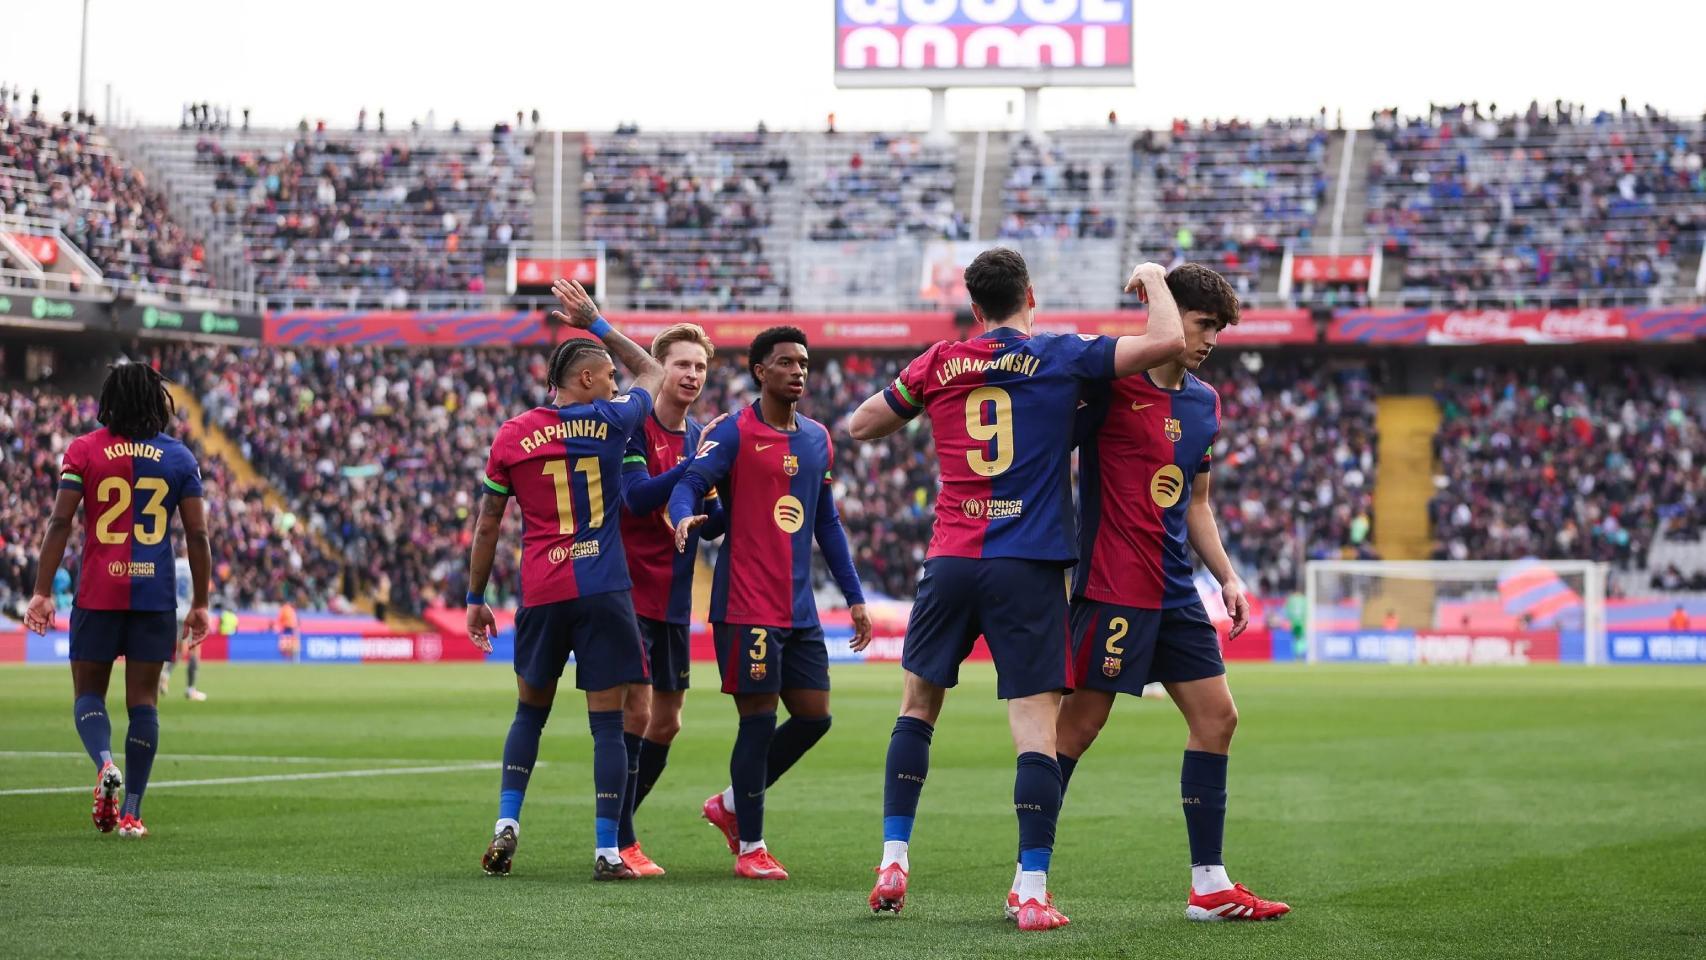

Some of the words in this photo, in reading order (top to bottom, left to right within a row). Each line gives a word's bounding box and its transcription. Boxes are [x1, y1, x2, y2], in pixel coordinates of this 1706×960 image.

[520, 419, 608, 453] RAPHINHA
[965, 386, 1014, 477] 9
[104, 442, 164, 462] KOUNDE
[96, 476, 170, 545] 23
[542, 456, 605, 535] 11
[986, 500, 1023, 508] UNHCR
[986, 507, 1022, 516] ACNUR
[569, 547, 600, 557] ACNUR
[750, 627, 768, 660] 3
[1106, 616, 1129, 655] 2
